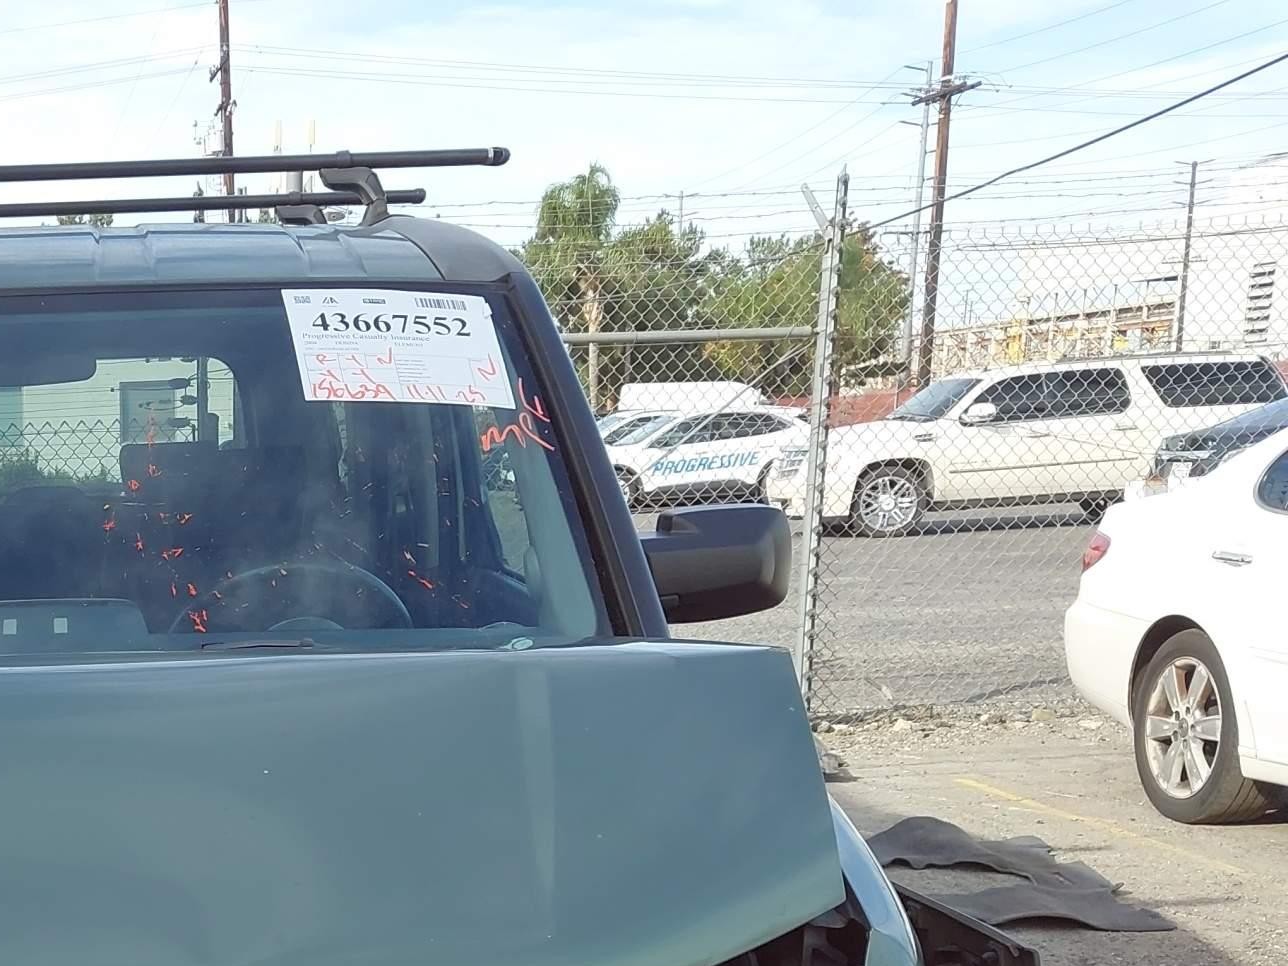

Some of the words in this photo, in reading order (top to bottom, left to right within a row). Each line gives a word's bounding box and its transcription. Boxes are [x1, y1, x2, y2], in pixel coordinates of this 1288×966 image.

[302, 332, 351, 341] Progressive
[352, 333, 388, 341] Casualty
[391, 333, 431, 342] Insurance
[312, 312, 471, 337] 43667552
[652, 451, 760, 476] PROGRESSIVE
